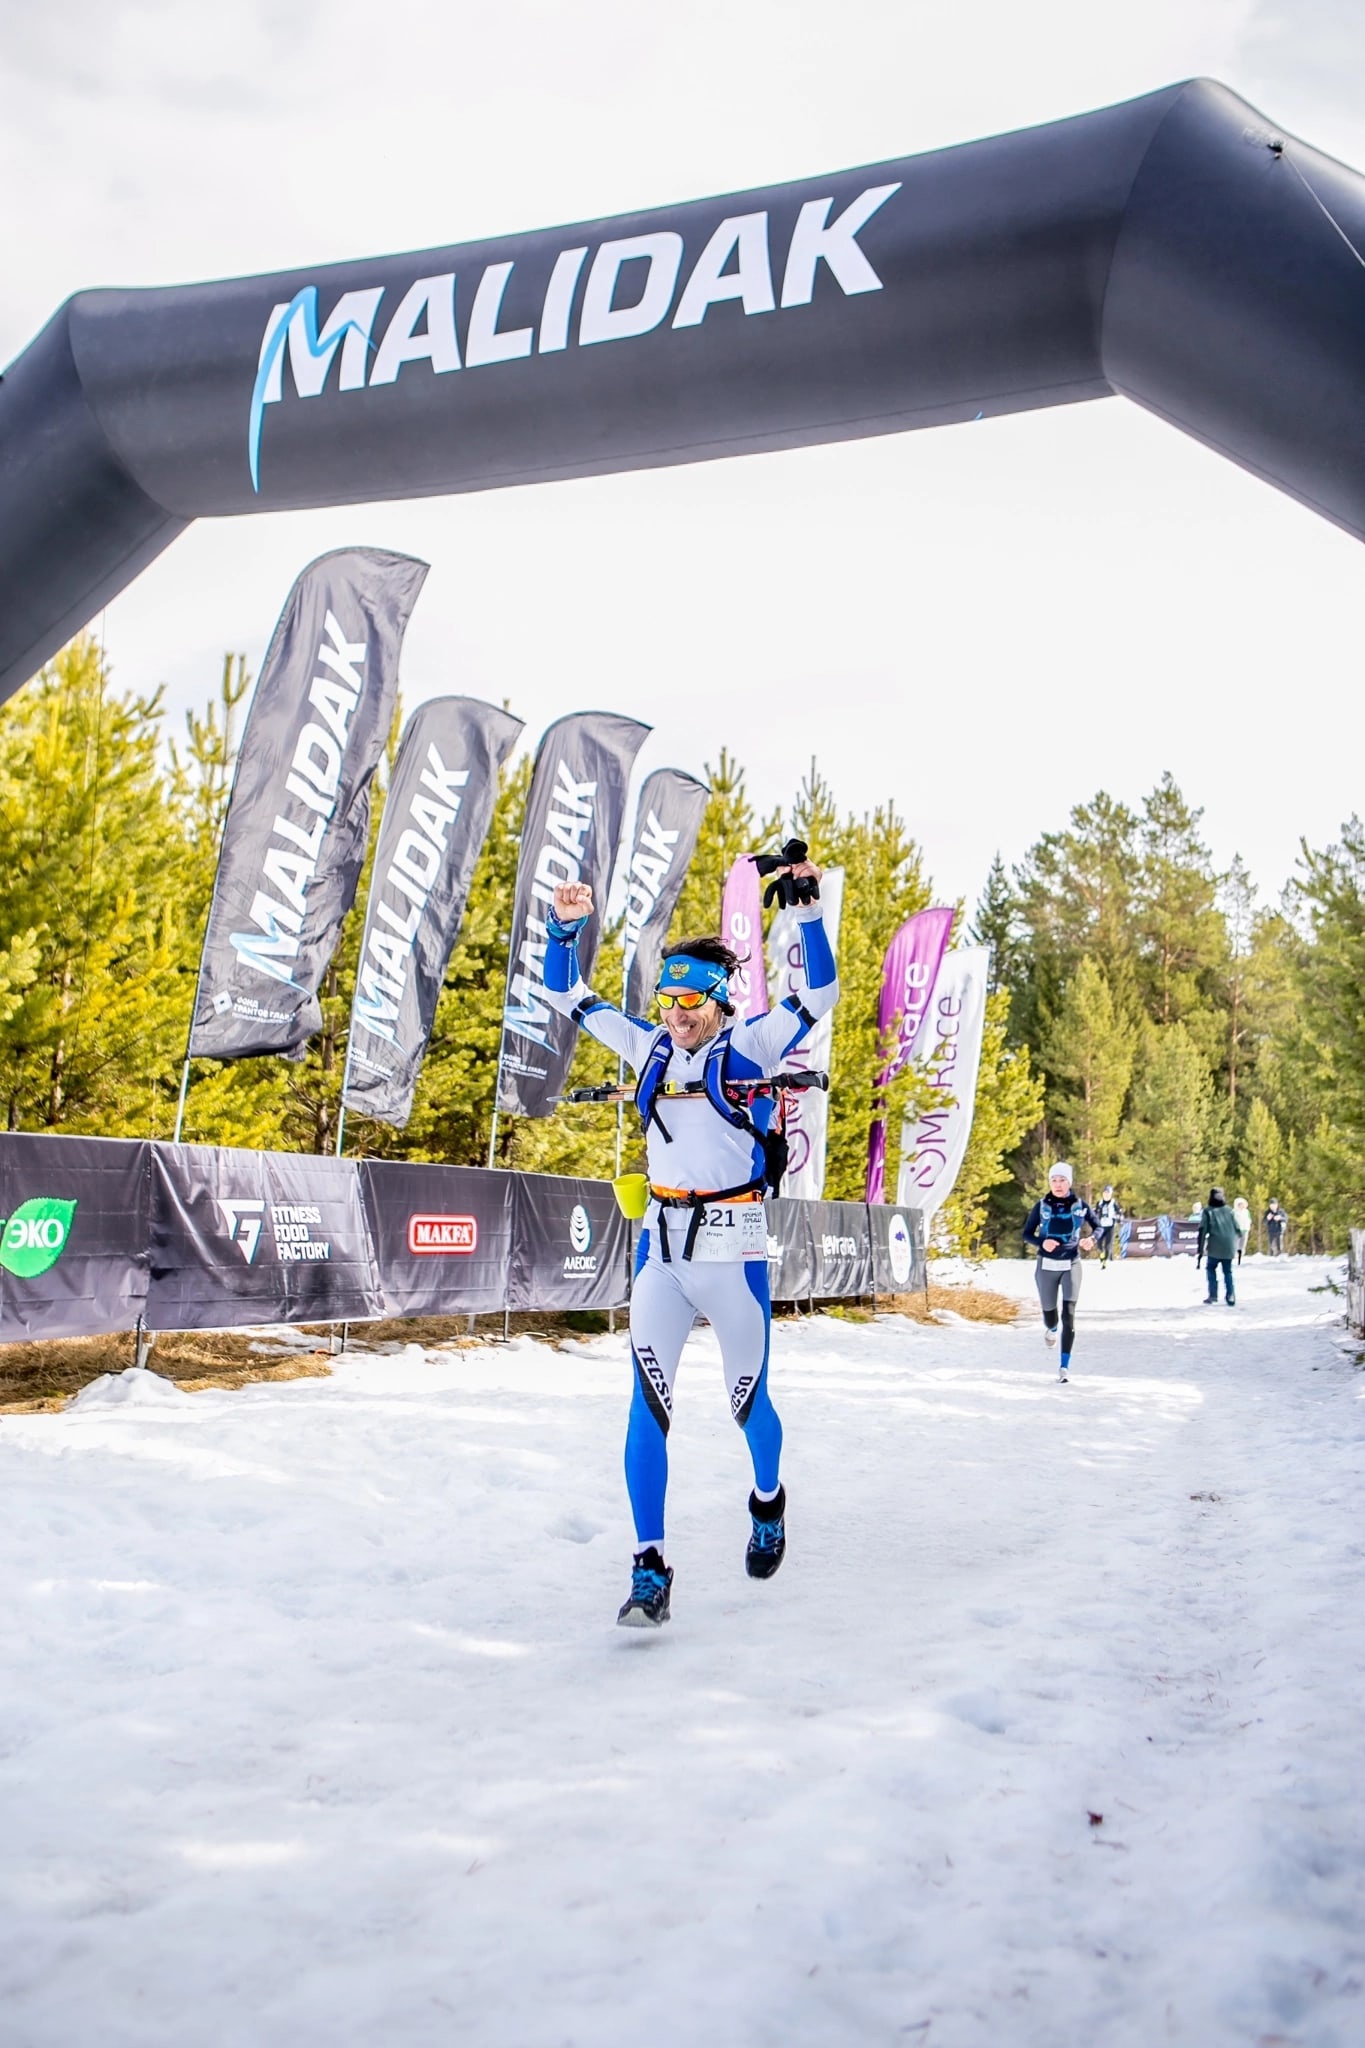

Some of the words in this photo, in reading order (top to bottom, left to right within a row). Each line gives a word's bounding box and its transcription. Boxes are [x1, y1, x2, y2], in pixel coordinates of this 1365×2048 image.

[249, 183, 902, 493] MALIDAK
[230, 610, 367, 988] MALIDAK
[355, 742, 470, 1052] MALIDAK
[270, 1206, 321, 1224] FITNESS
[7, 1218, 64, 1248] ЭКО
[273, 1224, 310, 1241] FOOD
[416, 1224, 472, 1244] MAKFA
[276, 1241, 330, 1260] FACTORY
